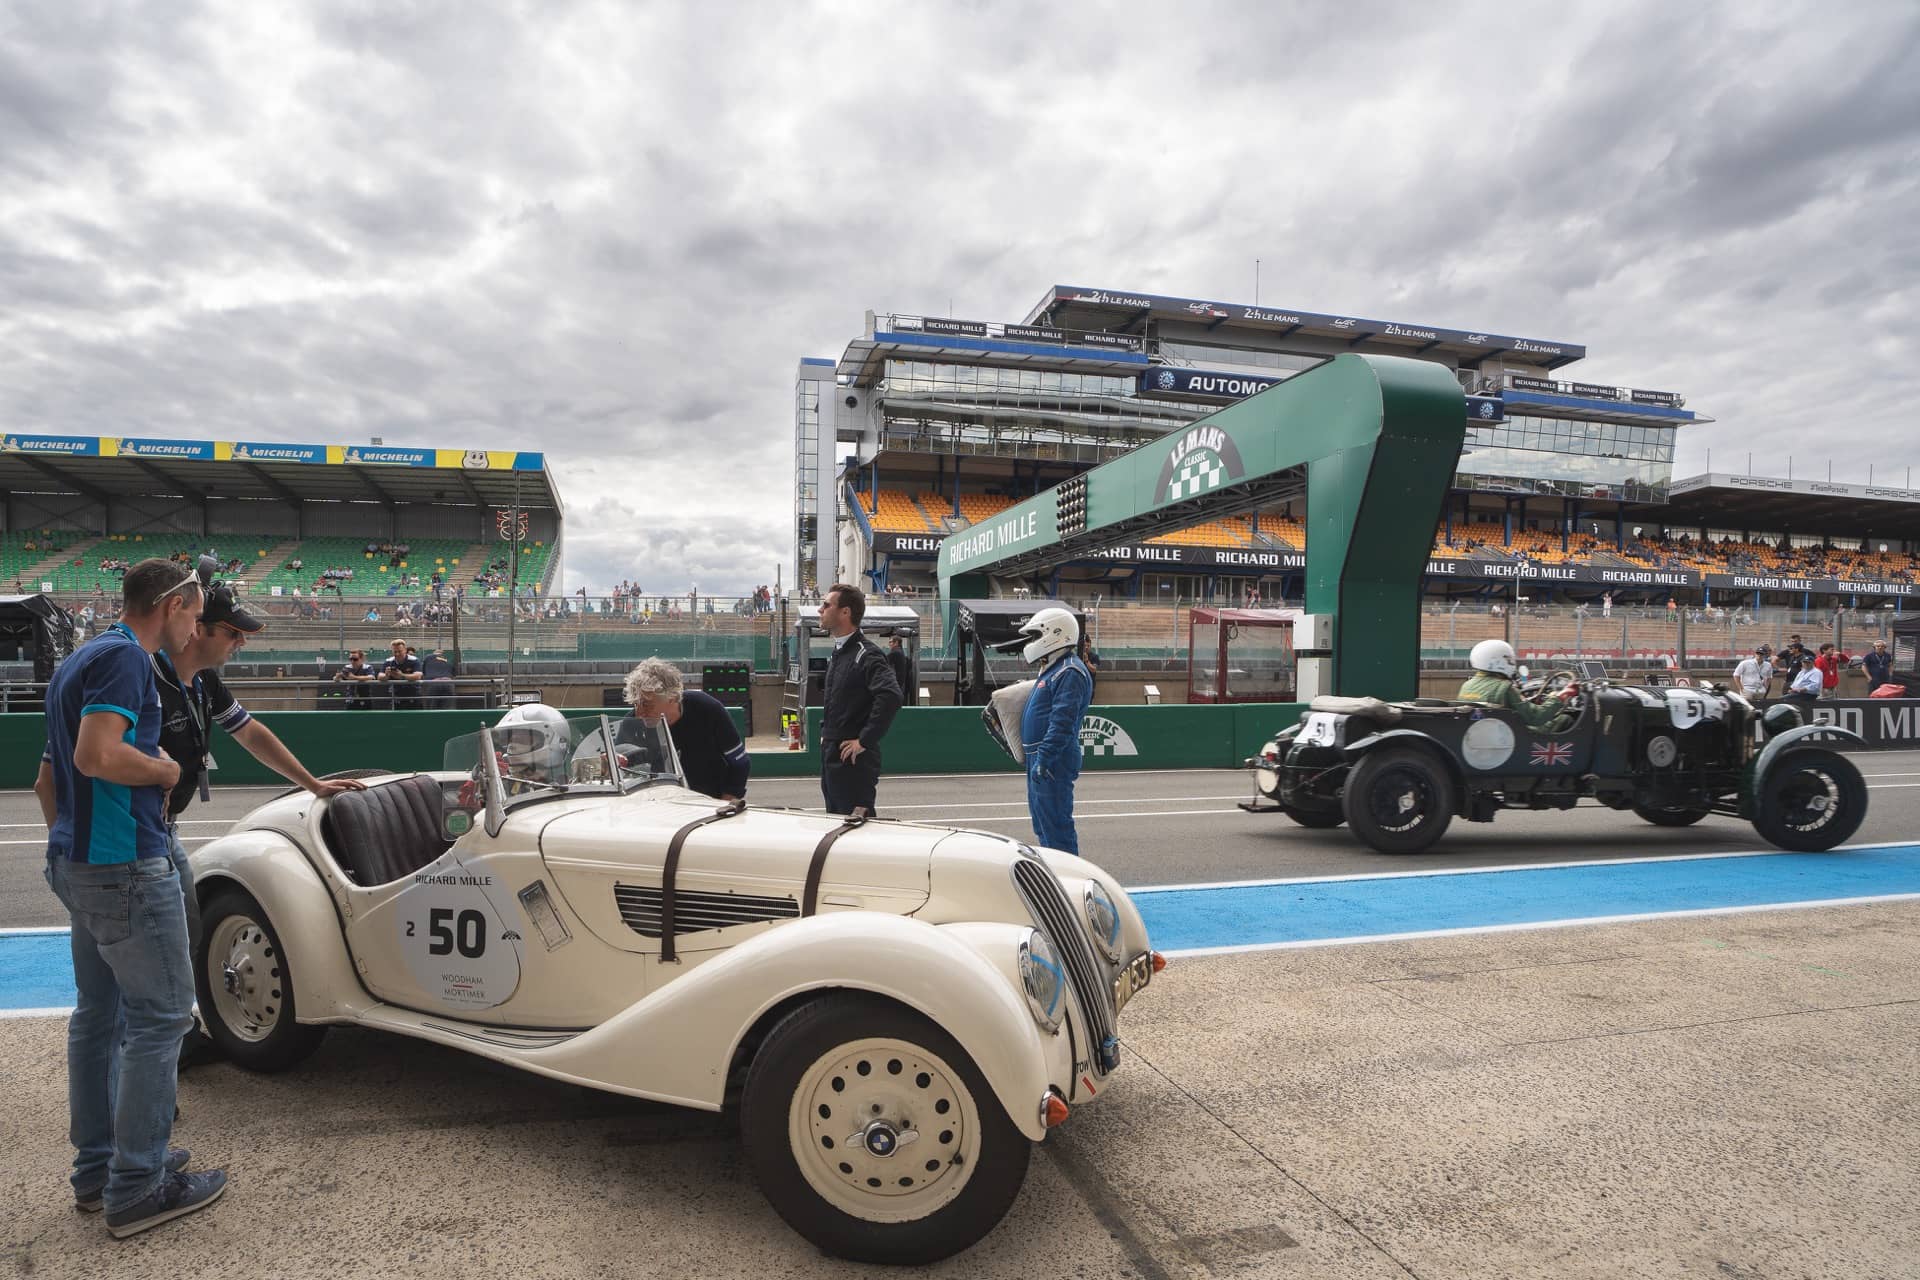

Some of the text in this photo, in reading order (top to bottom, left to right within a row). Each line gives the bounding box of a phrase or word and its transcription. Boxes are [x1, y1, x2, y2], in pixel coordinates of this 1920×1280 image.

[1123, 298, 1150, 307] MANS
[1274, 315, 1300, 323] MANS
[927, 321, 984, 333] RICHARD MILLE
[1007, 328, 1062, 339] RICHARD MILLE
[1413, 331, 1437, 339] MANS
[1085, 334, 1138, 345] RICHARD MILLE
[1540, 346, 1561, 354] MANS
[1515, 379, 1556, 389] RICHARD MILLE
[1634, 392, 1656, 400] RICHARD
[22, 441, 87, 450] MICHELIN
[139, 445, 201, 454] MICHELIN
[1171, 426, 1226, 469] LE MANS
[252, 449, 314, 458] MICHELIN
[363, 453, 424, 462] MICHELIN
[1184, 451, 1207, 467] CLASSIC
[1730, 478, 1792, 488] PORSCHE
[950, 511, 1037, 565] RICHARD MILLE
[1136, 548, 1181, 560] MILLE
[1215, 552, 1278, 565] RICHARD
[1484, 565, 1576, 579] RICHARD MILLE
[1603, 571, 1687, 584] RICHARD MILLE
[1734, 577, 1812, 589] RICHARD MILLE
[1838, 582, 1912, 594] RICHARD MILLE
[415, 874, 492, 886] RICHARD MILLE
[406, 908, 486, 958] 2 50
[442, 974, 484, 984] WOODHAM
[444, 988, 486, 998] MORTIMER
